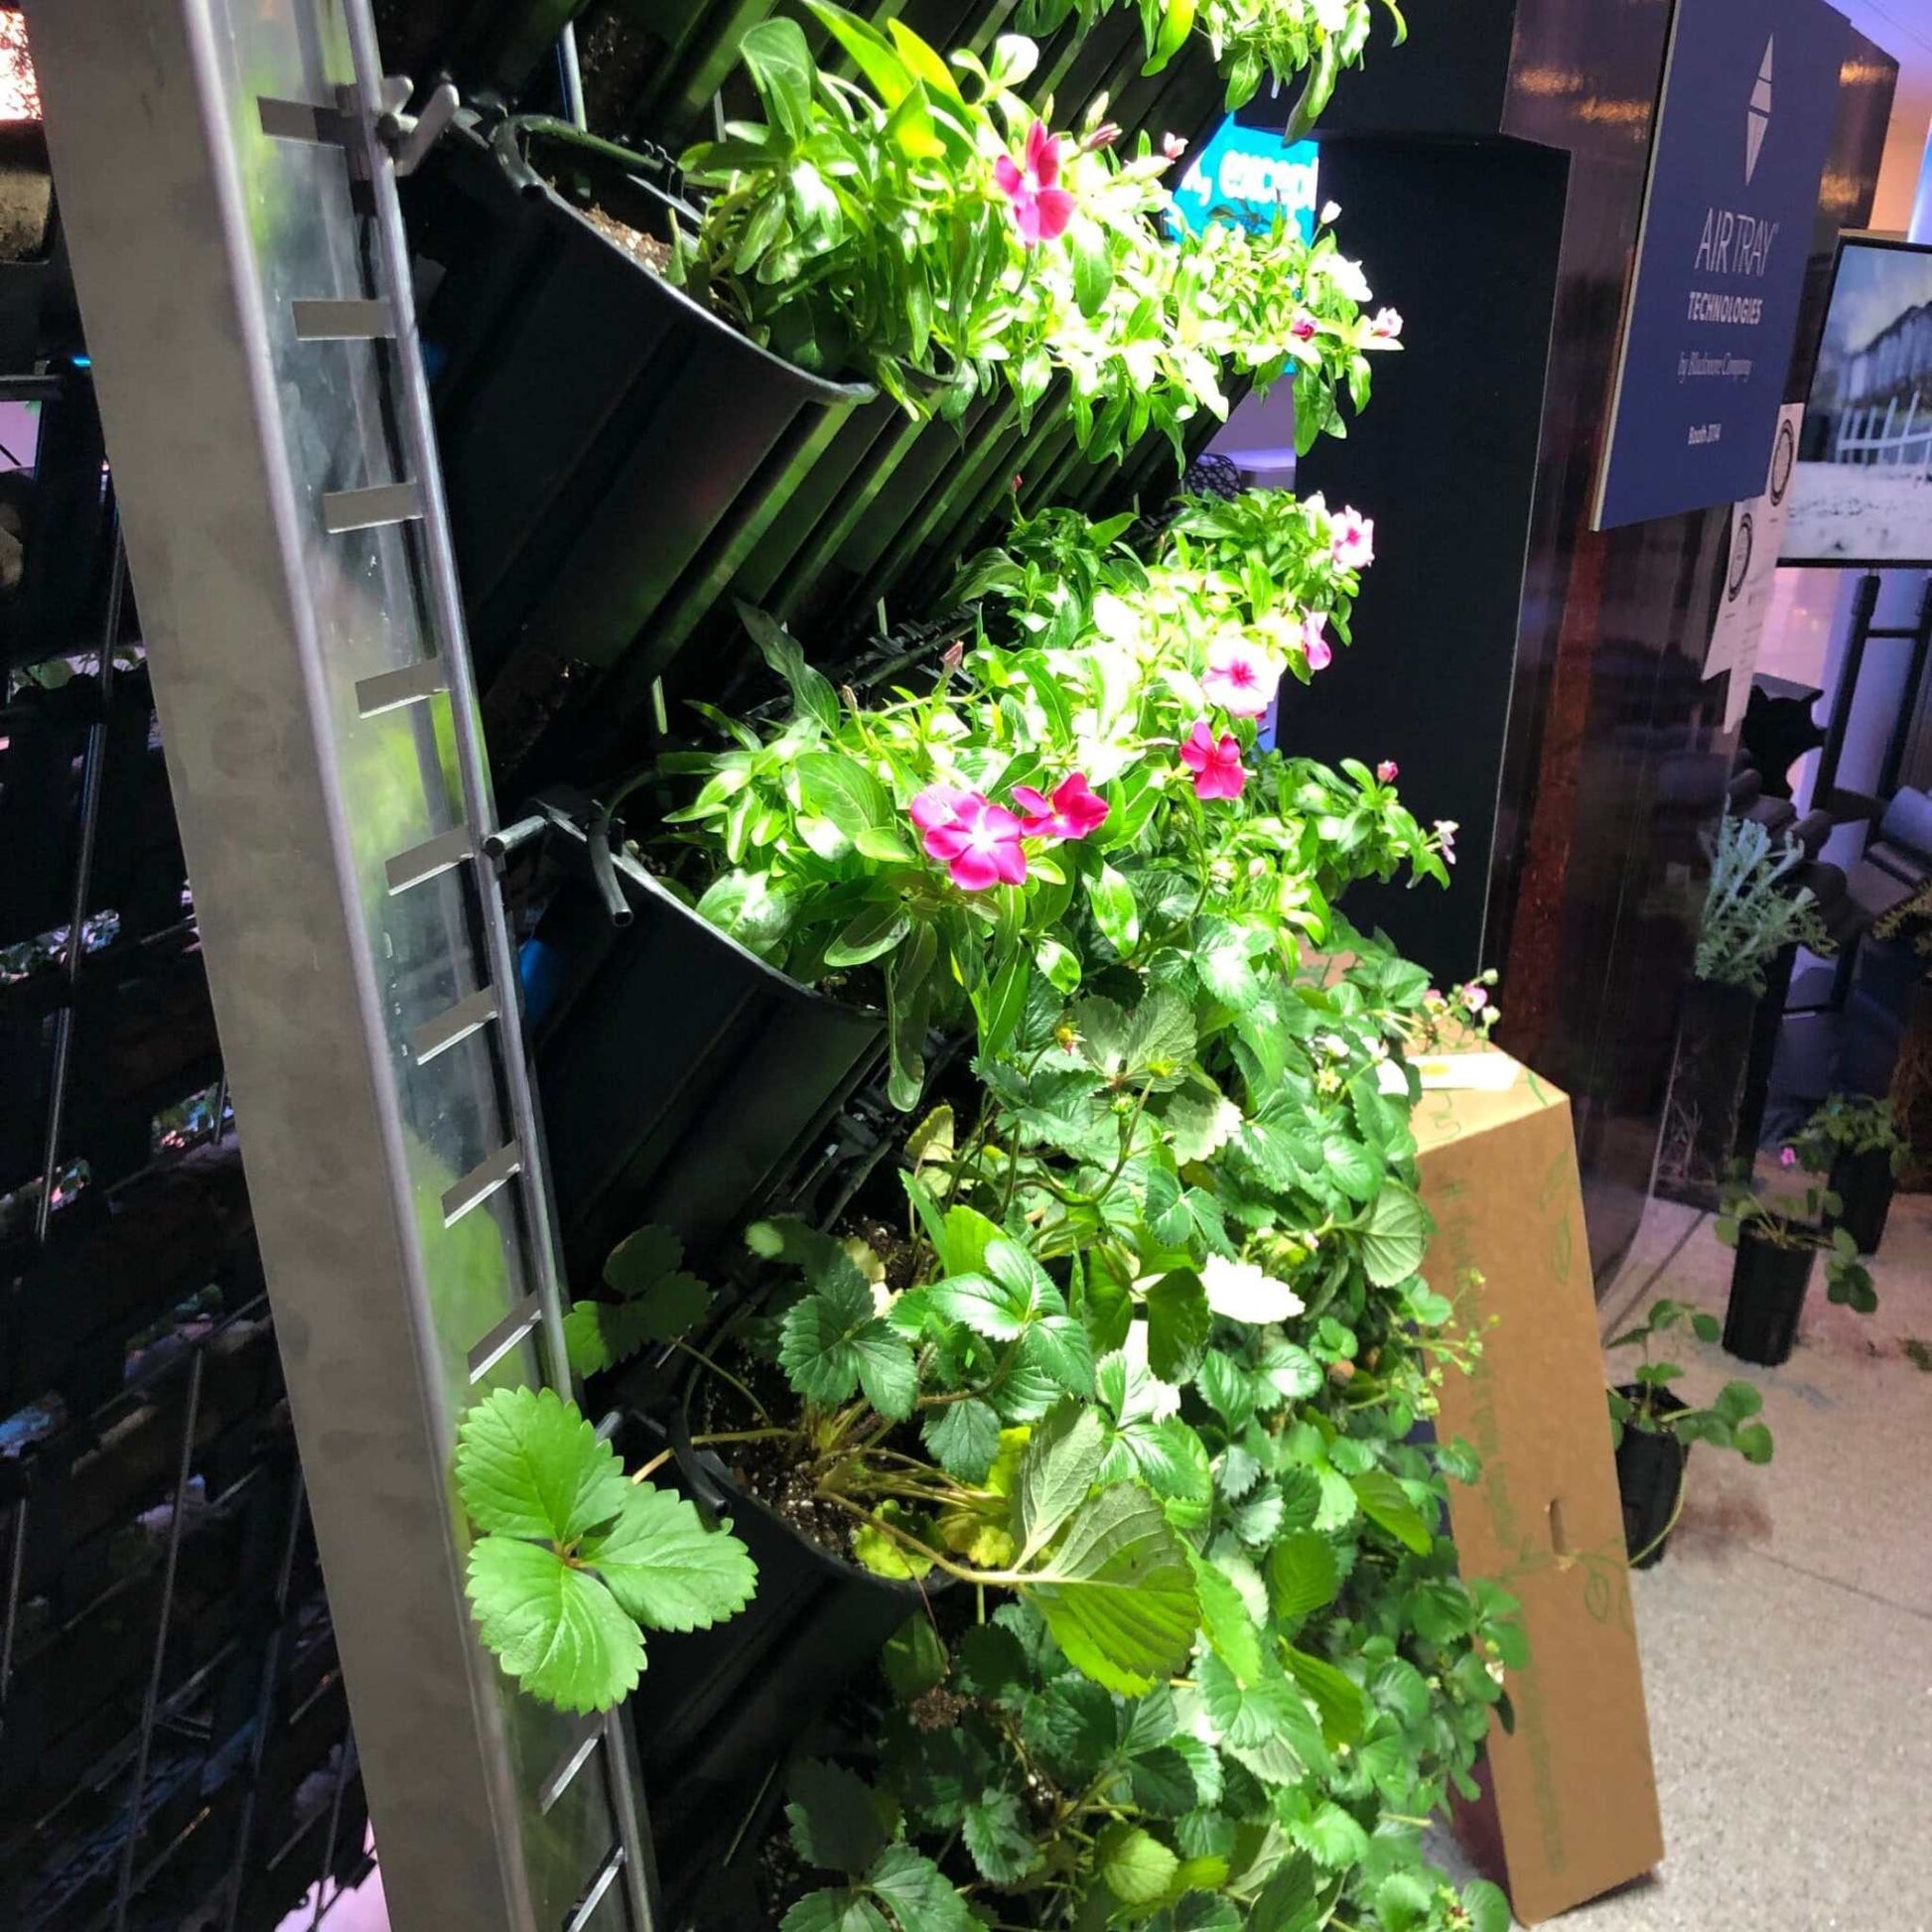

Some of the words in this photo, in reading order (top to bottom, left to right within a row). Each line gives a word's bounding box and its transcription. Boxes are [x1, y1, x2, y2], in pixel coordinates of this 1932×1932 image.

[1688, 291, 1763, 326] TECHNOLOGIES
[1678, 351, 1689, 384] by
[1722, 351, 1753, 383] Company
